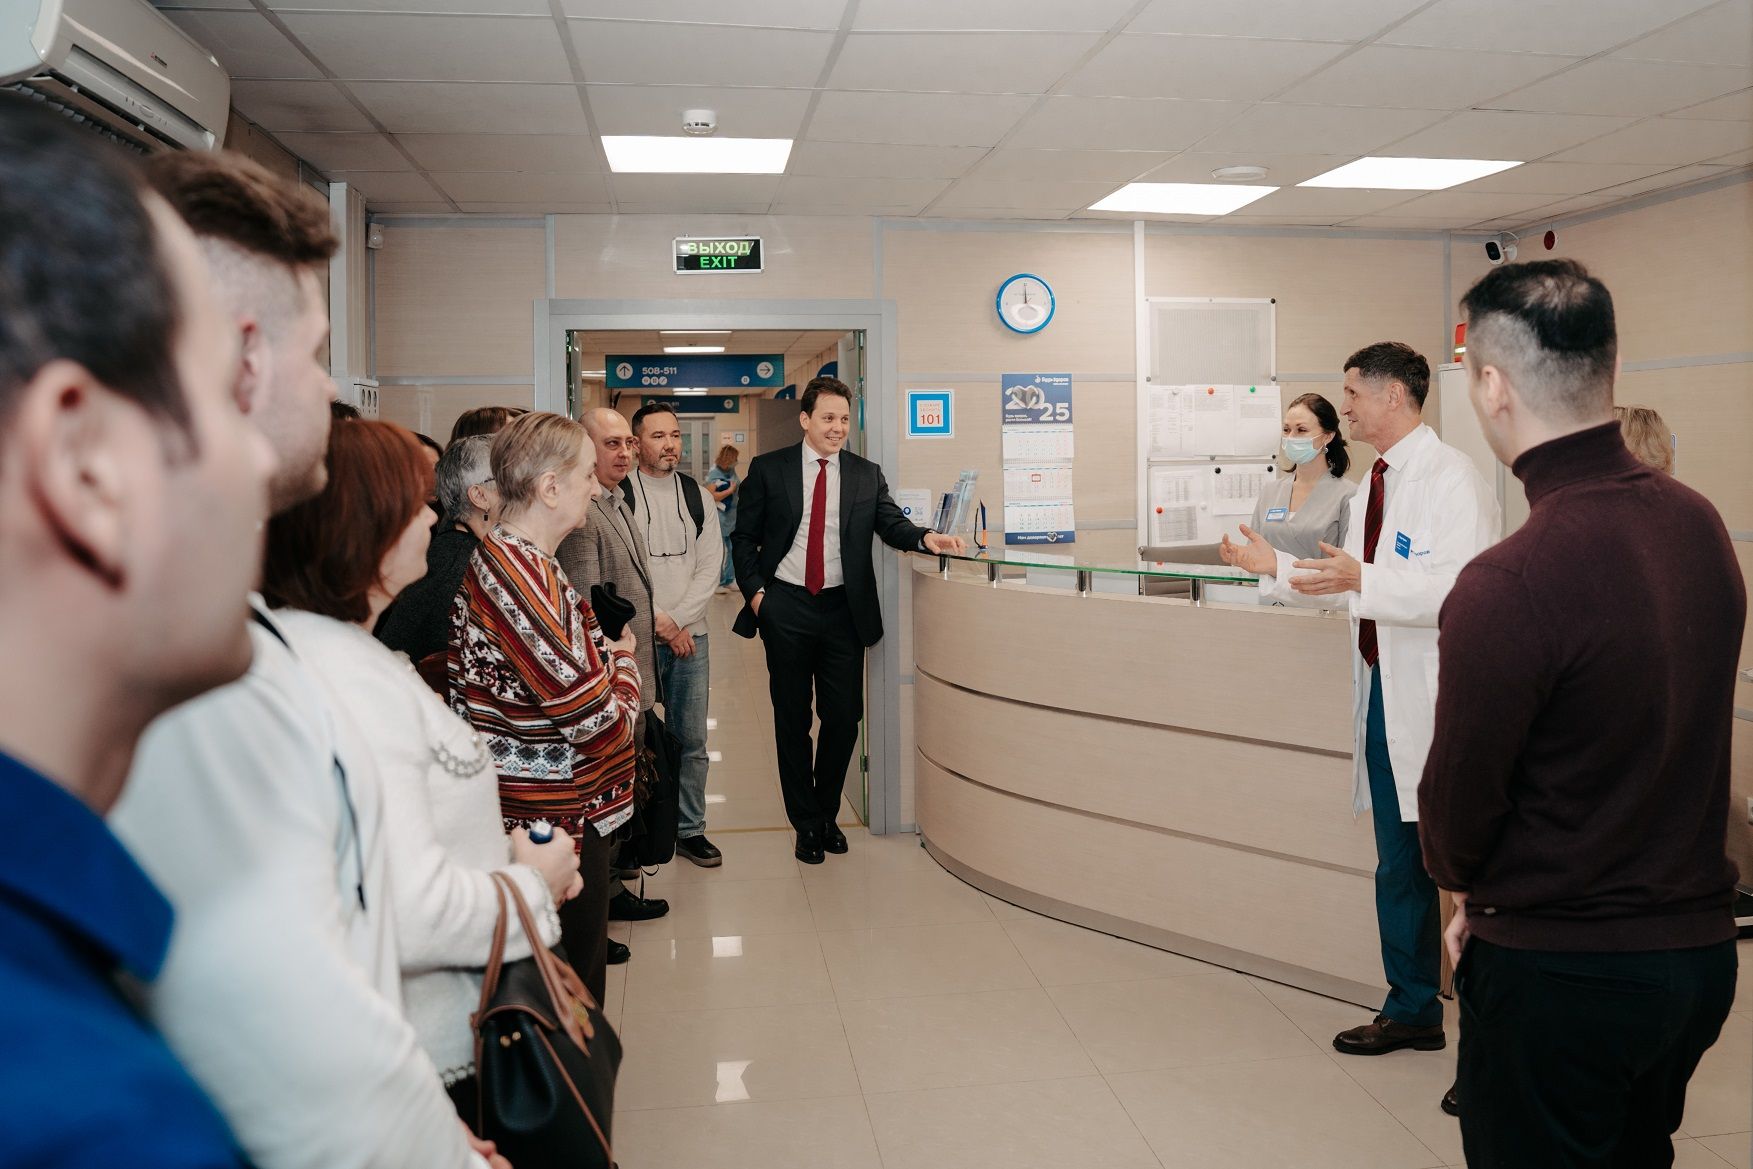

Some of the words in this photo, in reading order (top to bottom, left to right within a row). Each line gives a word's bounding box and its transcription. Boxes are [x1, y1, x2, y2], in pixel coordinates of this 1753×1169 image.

[687, 242, 750, 255] ВЫХОД
[700, 256, 737, 268] EXIT
[642, 366, 677, 375] 508-511
[921, 414, 940, 425] 101
